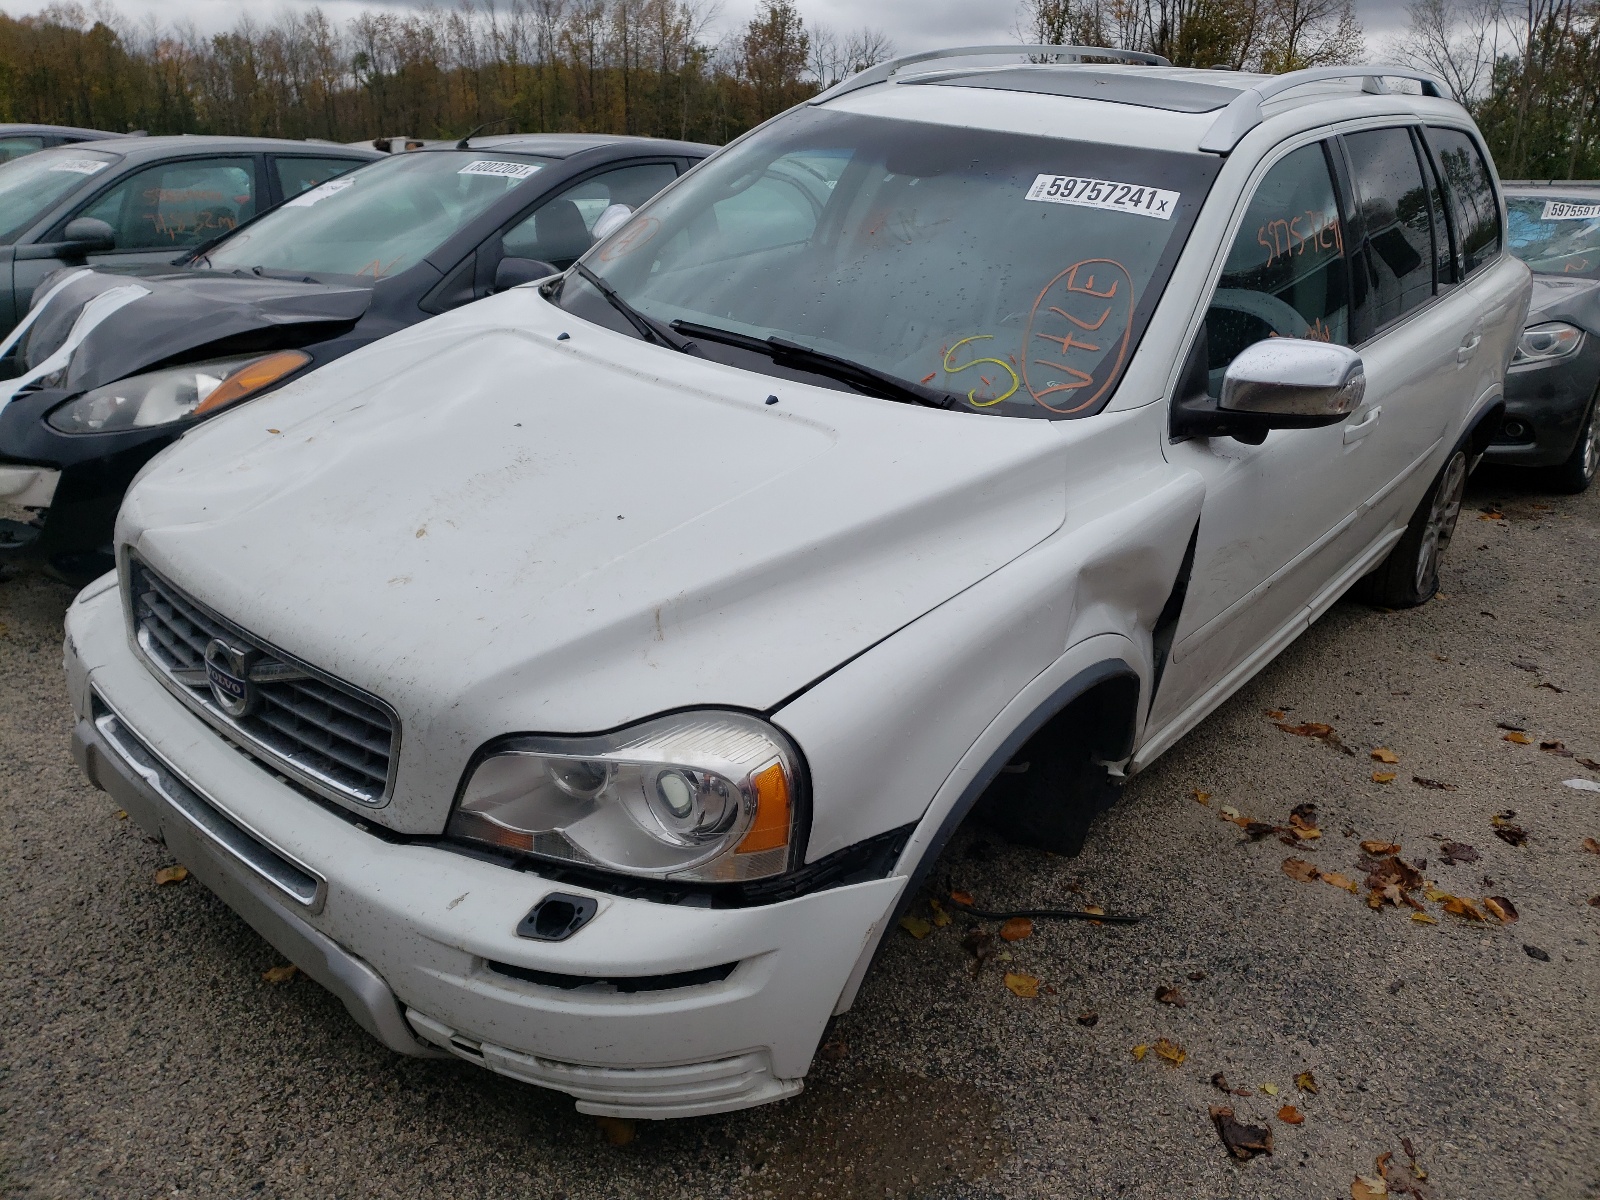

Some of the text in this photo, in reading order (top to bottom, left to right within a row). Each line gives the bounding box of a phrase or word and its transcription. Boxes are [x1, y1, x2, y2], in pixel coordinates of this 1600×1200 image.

[1046, 176, 1158, 210] 59757241
[943, 334, 1020, 407] S
[208, 667, 241, 694] VOLVO
